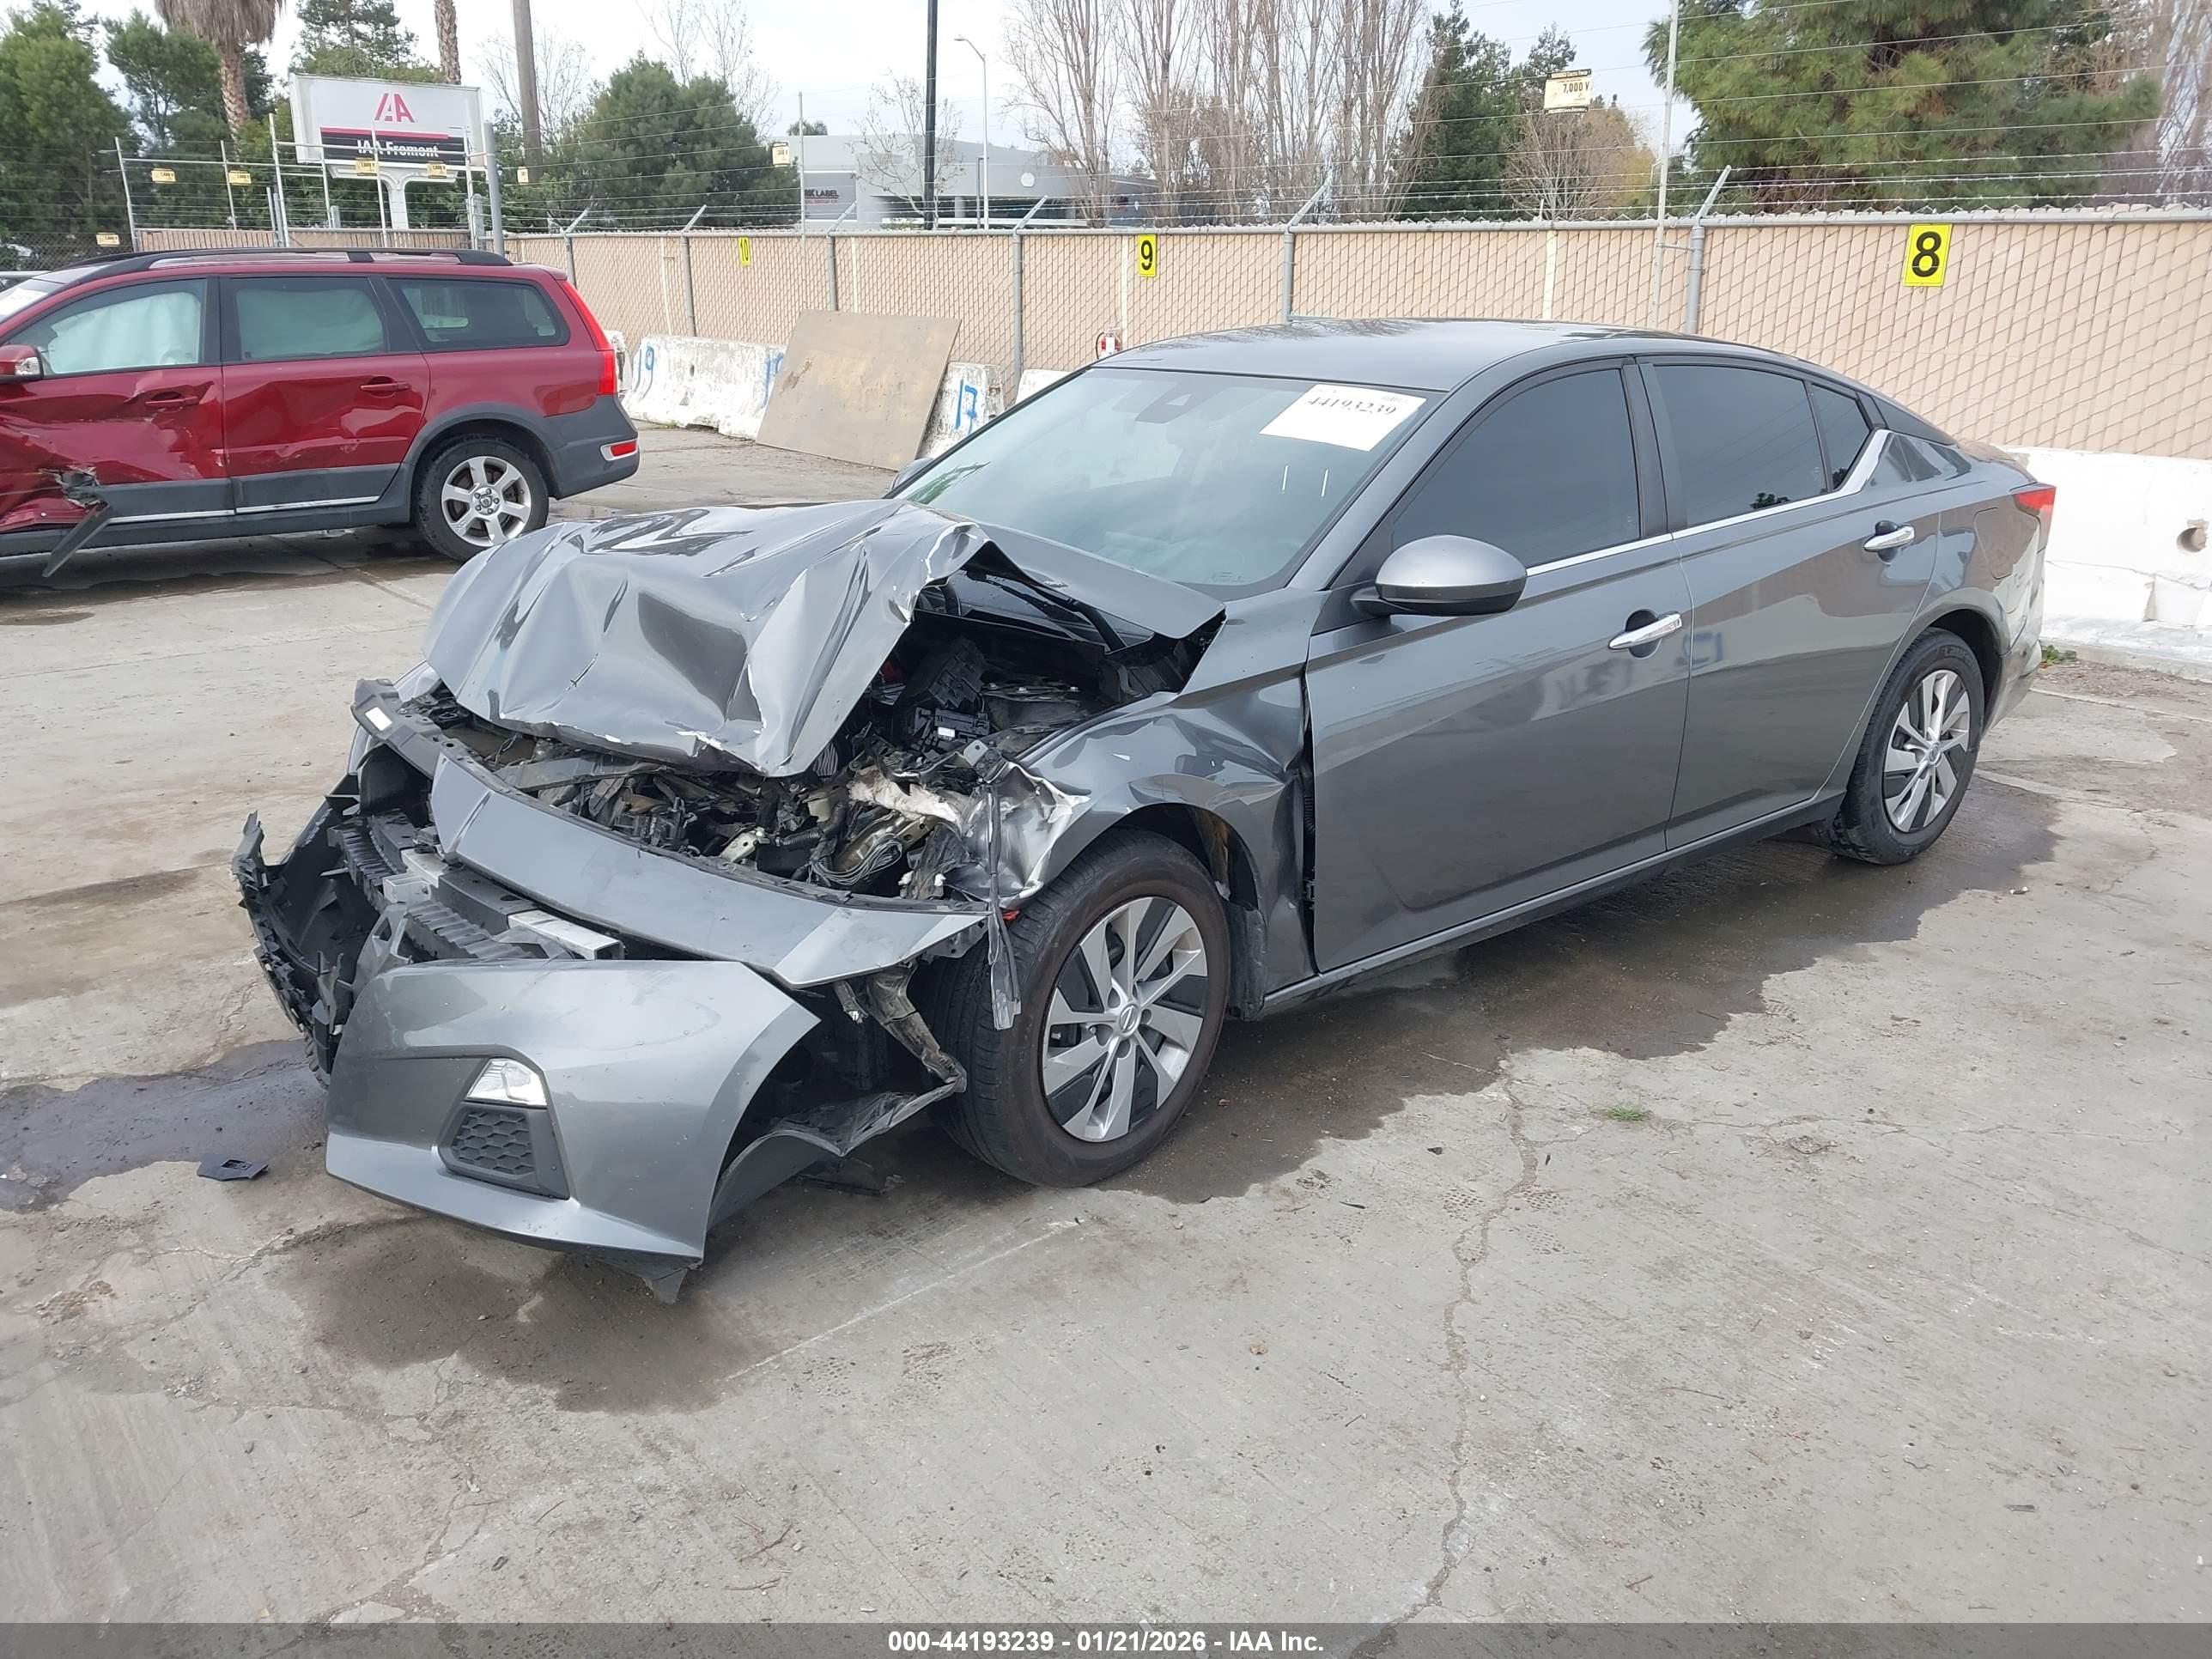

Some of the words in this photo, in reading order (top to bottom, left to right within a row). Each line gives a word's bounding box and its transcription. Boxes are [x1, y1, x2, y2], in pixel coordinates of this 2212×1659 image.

[1563, 82, 1583, 94] 7,000
[1585, 81, 1590, 91] V
[740, 238, 749, 261] 10
[1140, 240, 1153, 270] 9
[1911, 231, 1942, 277] 8
[1306, 396, 1397, 415] 44193239
